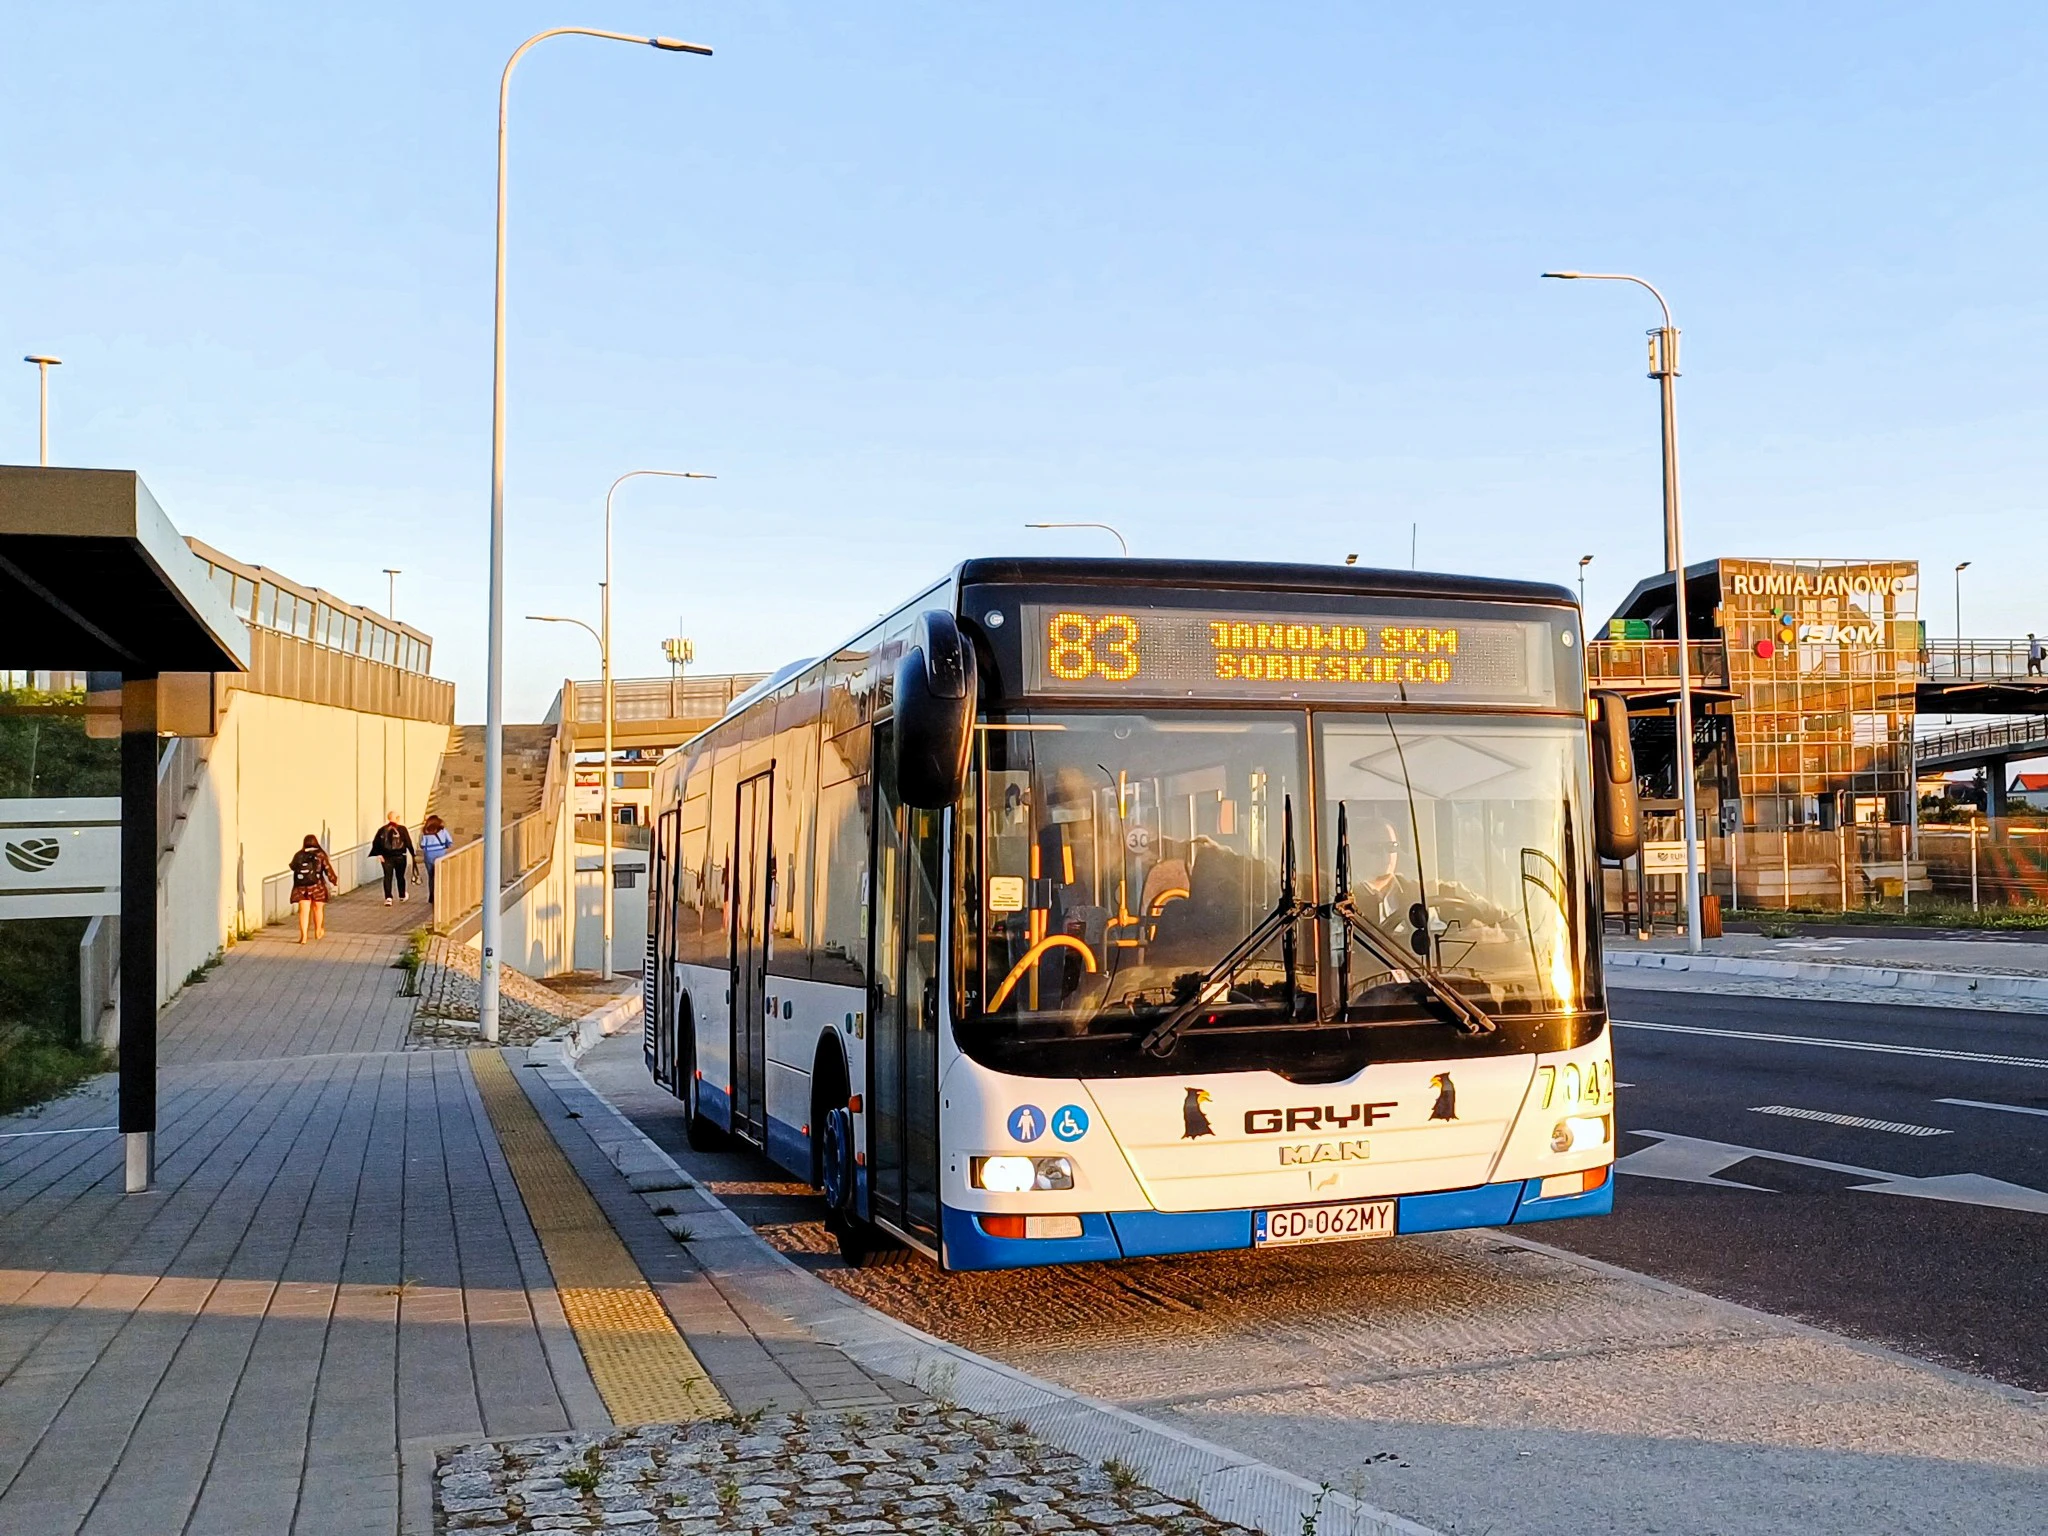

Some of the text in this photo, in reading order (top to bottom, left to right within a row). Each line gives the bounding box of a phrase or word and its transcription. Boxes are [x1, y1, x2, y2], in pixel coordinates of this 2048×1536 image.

[1732, 574, 1907, 597] RUMIA JANOWO
[1048, 612, 1140, 681] 83
[1209, 620, 1458, 654] JANOWO SKM
[1806, 625, 1885, 645] SKM
[1215, 654, 1452, 685] SOBIESKIEGO
[1129, 833, 1148, 848] 30
[1244, 1101, 1398, 1134] GRYF
[1279, 1140, 1370, 1166] MAN
[1271, 1212, 1307, 1238] GD
[1316, 1204, 1389, 1234] 062MY
